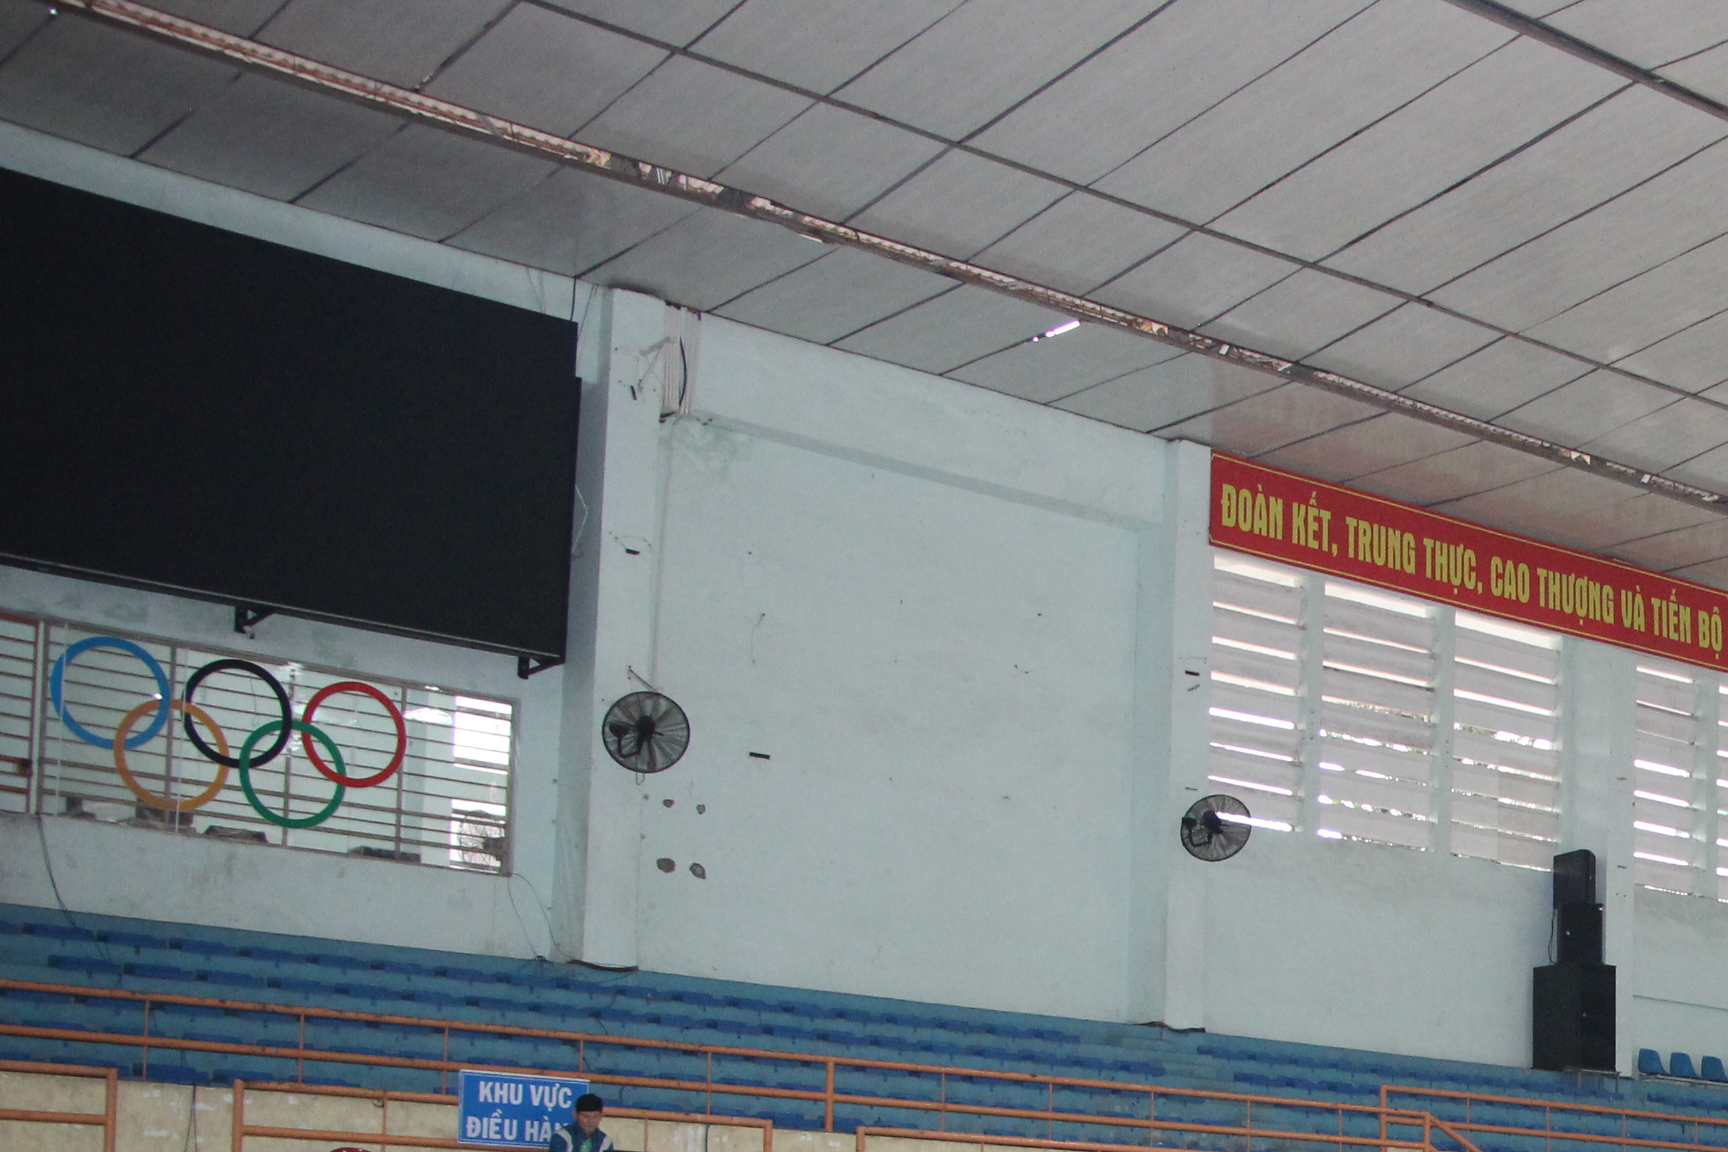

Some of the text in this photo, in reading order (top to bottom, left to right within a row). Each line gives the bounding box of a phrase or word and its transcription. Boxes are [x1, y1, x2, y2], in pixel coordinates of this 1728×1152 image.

[1221, 483, 1284, 541] ĐOÀN
[1292, 491, 1338, 557] KẾT,
[1346, 515, 1416, 575] TRUNG
[1423, 537, 1483, 595] THỰC,
[1490, 556, 1530, 604] CAO
[1536, 567, 1616, 626] THƯỢNG
[1651, 588, 1693, 645] TIẾN
[1698, 606, 1724, 660] BỘ
[479, 1081, 573, 1112] KHU VỰC
[466, 1108, 518, 1141] ĐIỀU
